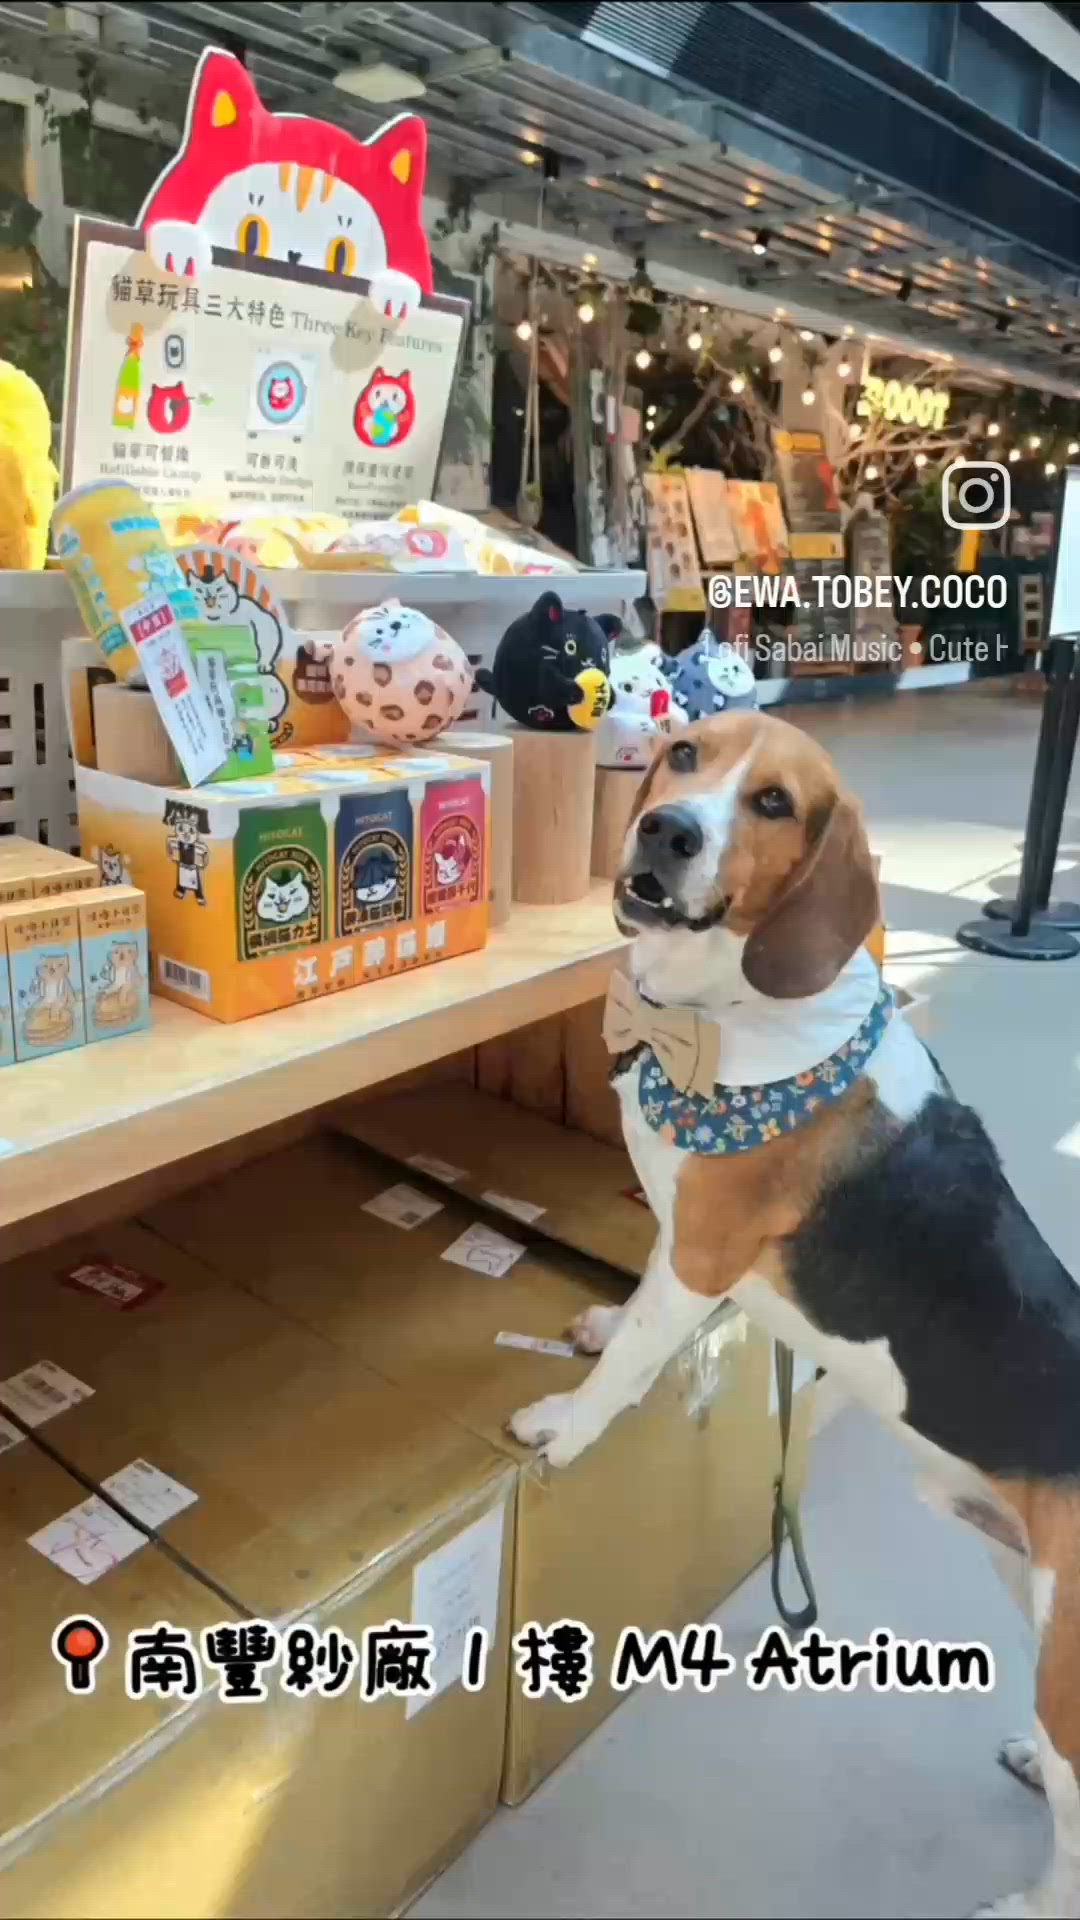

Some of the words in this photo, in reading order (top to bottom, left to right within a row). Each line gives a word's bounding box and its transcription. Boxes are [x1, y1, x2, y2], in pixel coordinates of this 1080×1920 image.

[111, 274, 286, 329] 貓草玩具三大特色
[291, 311, 337, 334] Three
